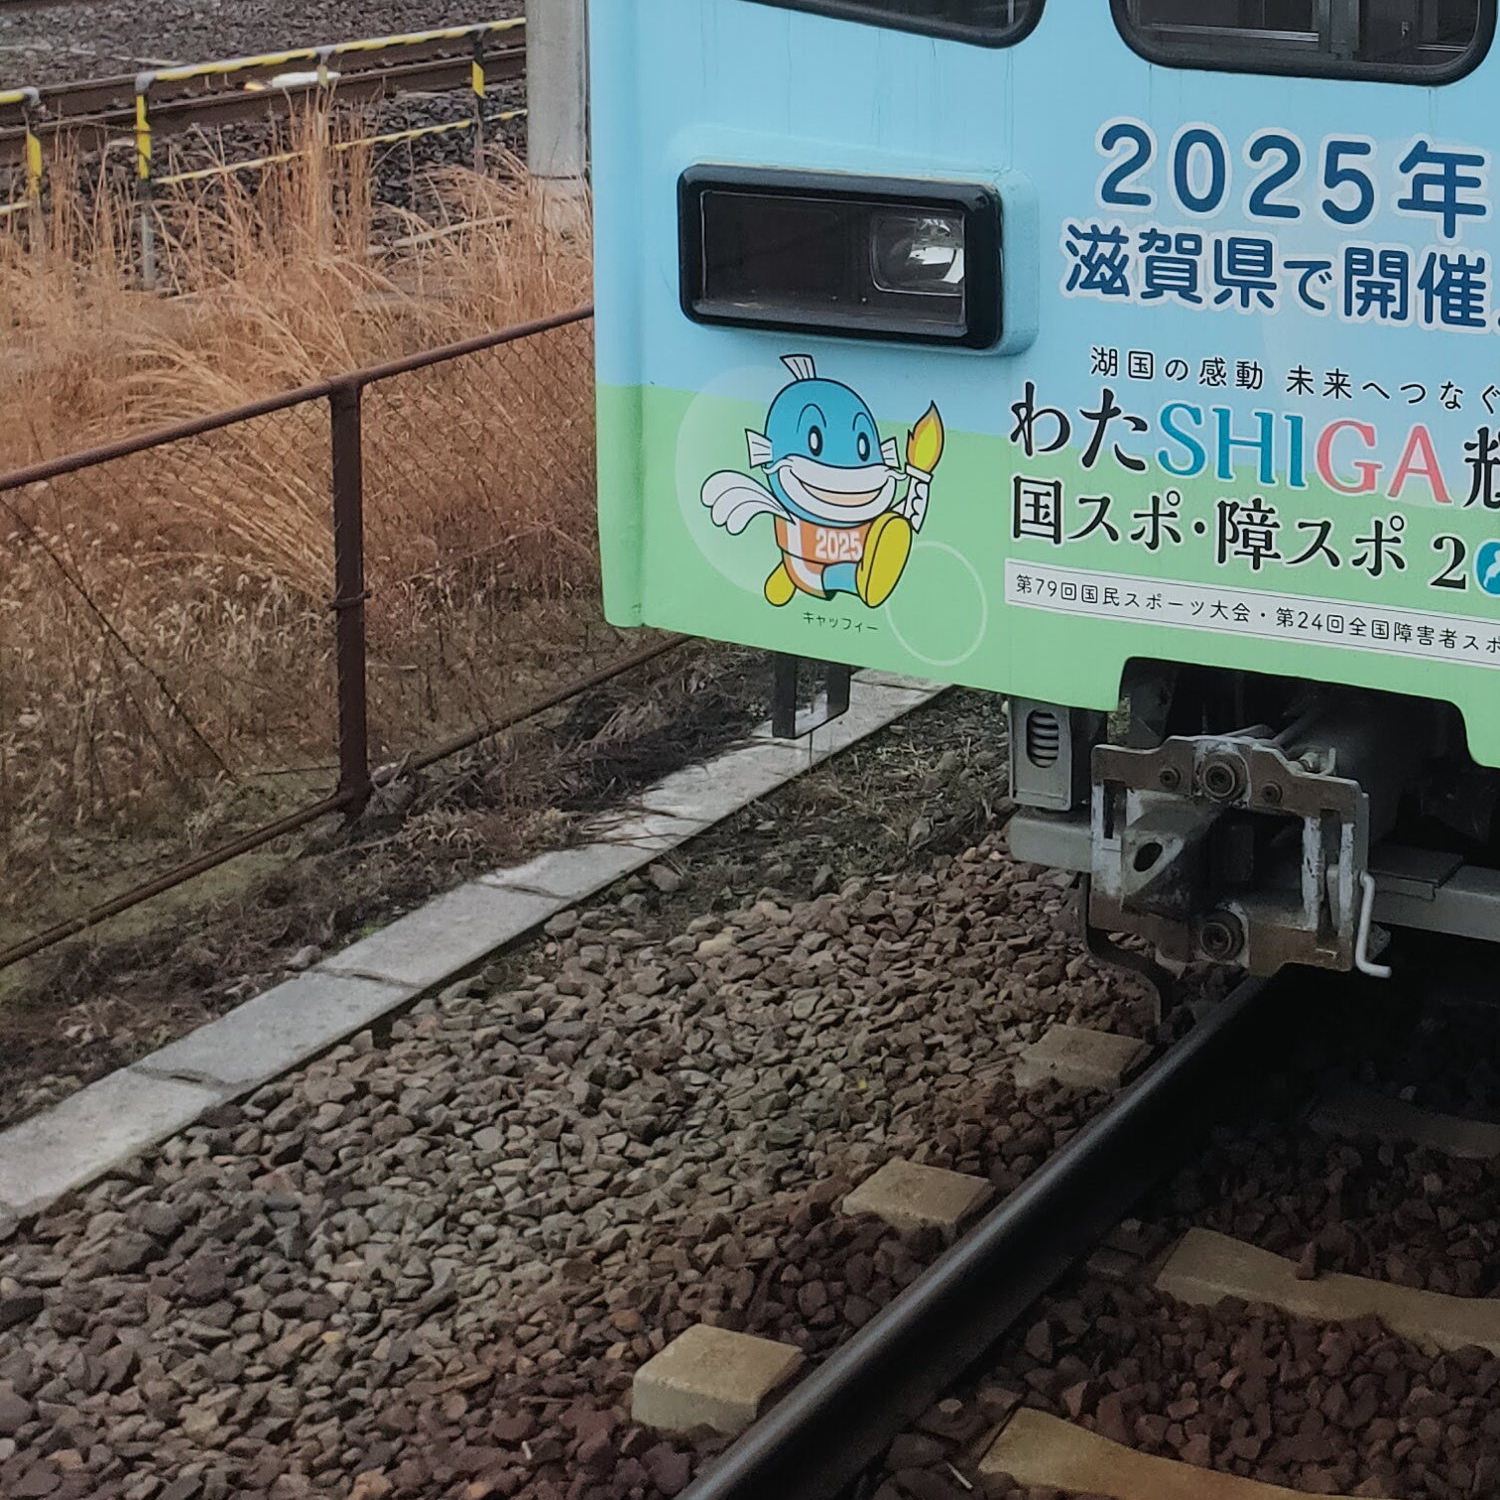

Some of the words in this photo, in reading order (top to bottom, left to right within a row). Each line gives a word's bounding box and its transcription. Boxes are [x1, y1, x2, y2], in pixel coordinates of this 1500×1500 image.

[1099, 122, 1488, 240] 2025年
[1090, 346, 1265, 391] 湖国の感動
[814, 528, 863, 562] 2025
[1011, 475, 1407, 577] 国スポ・障スポ
[802, 611, 879, 632] キャッフィー
